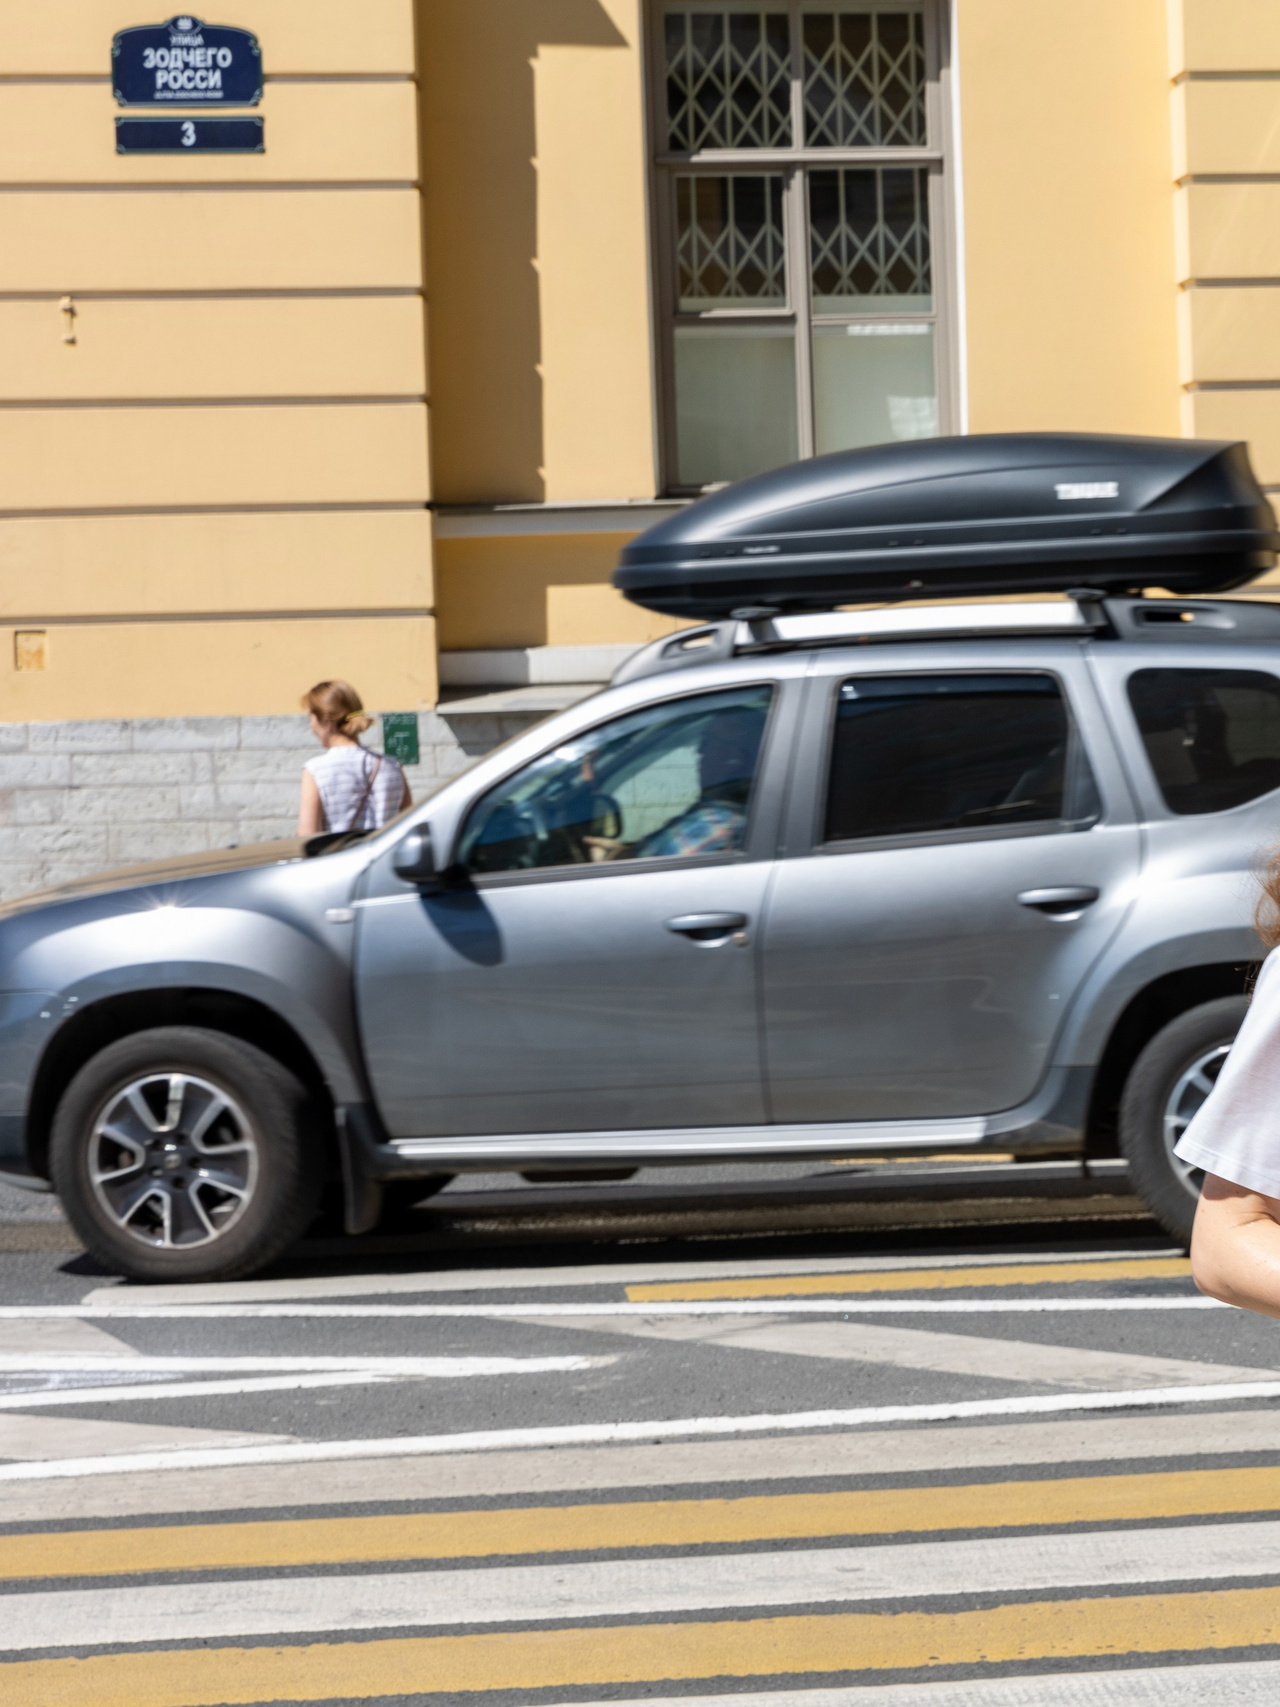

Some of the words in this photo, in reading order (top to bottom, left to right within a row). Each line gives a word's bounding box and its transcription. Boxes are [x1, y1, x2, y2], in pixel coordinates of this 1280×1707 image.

[169, 34, 204, 47] УЛИЦА
[142, 46, 233, 70] ЗОДЧЕГО
[155, 68, 222, 90] РОССИ
[180, 119, 197, 147] 3
